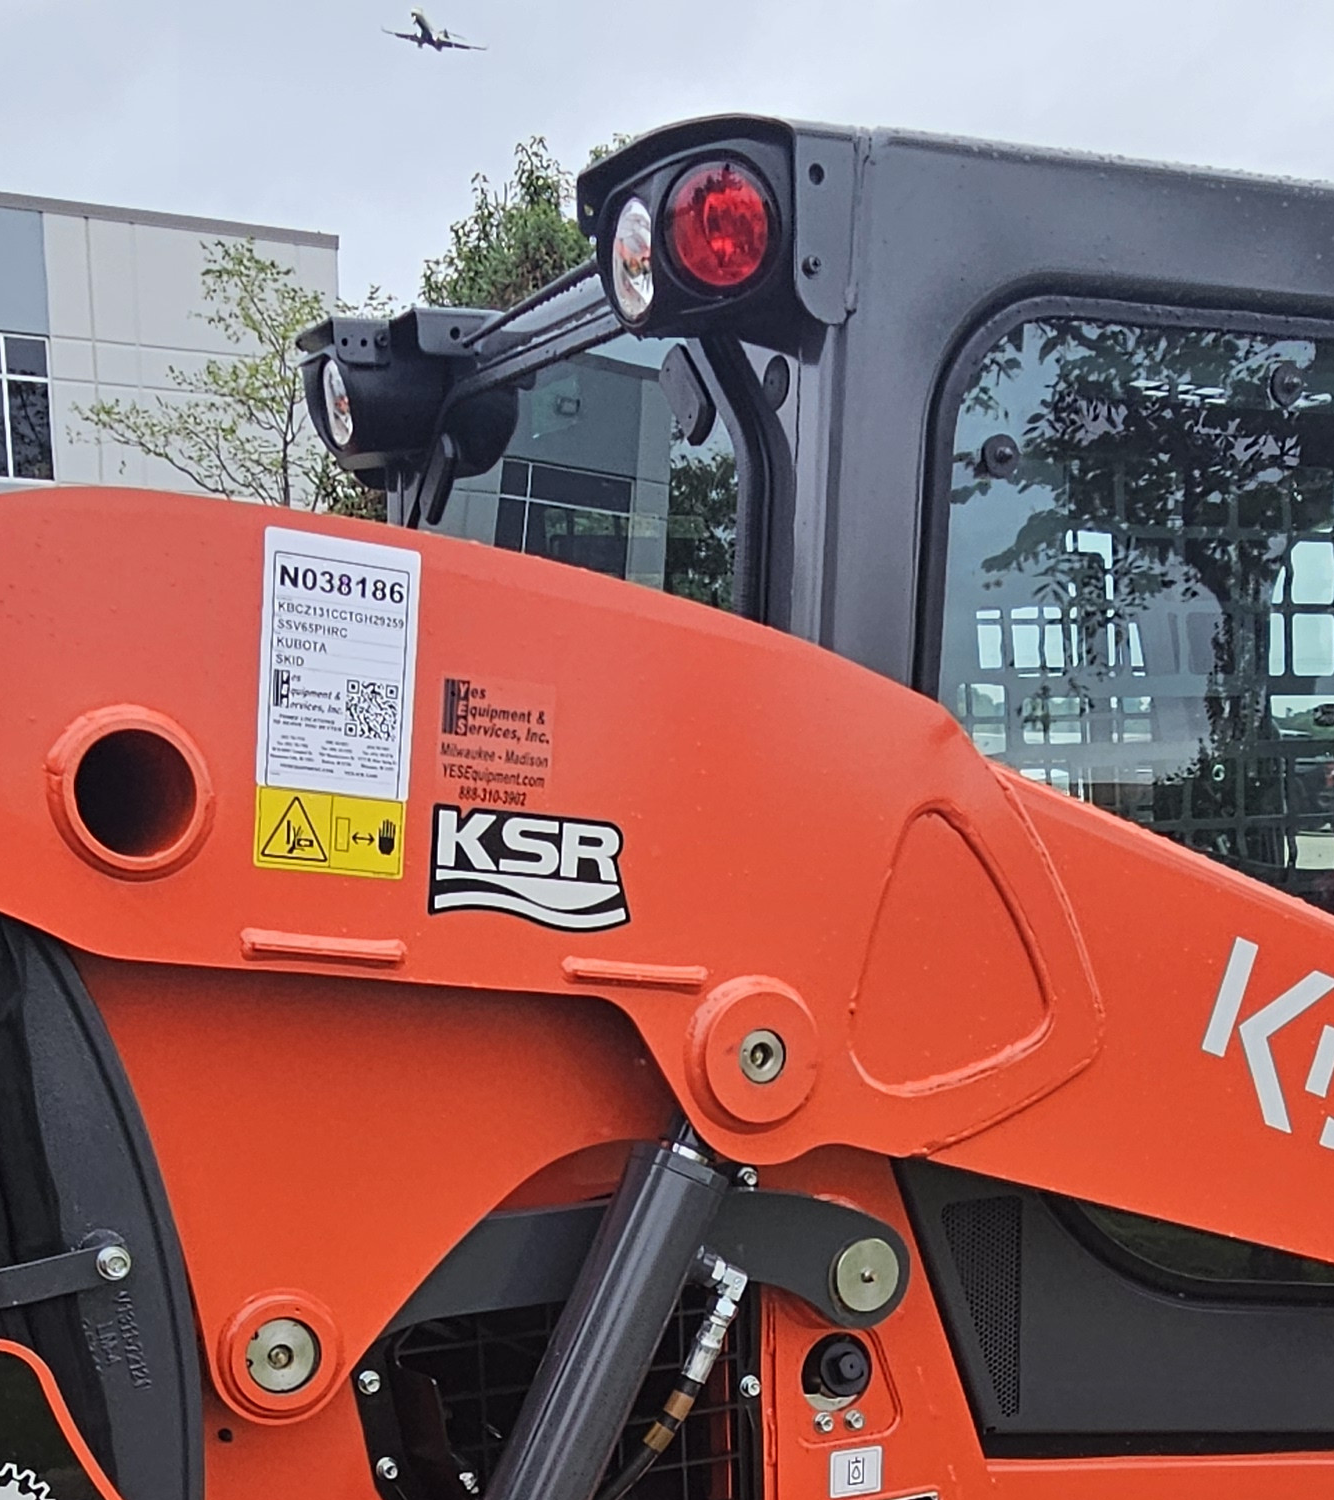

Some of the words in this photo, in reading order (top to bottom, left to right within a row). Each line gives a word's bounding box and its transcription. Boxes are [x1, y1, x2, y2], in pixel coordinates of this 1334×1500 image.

[280, 564, 404, 604] N038186
[276, 636, 327, 654] KUBOTA
[275, 653, 305, 666] SKID
[459, 681, 486, 699] Yes
[457, 701, 531, 724] Equipment
[536, 710, 545, 725] &
[456, 719, 522, 742] Services,
[525, 727, 550, 744] Inc.
[440, 742, 495, 761] Milwaukee
[504, 749, 549, 768] Madison
[442, 762, 546, 788] YESEquipment.com
[437, 809, 620, 882] KSR
